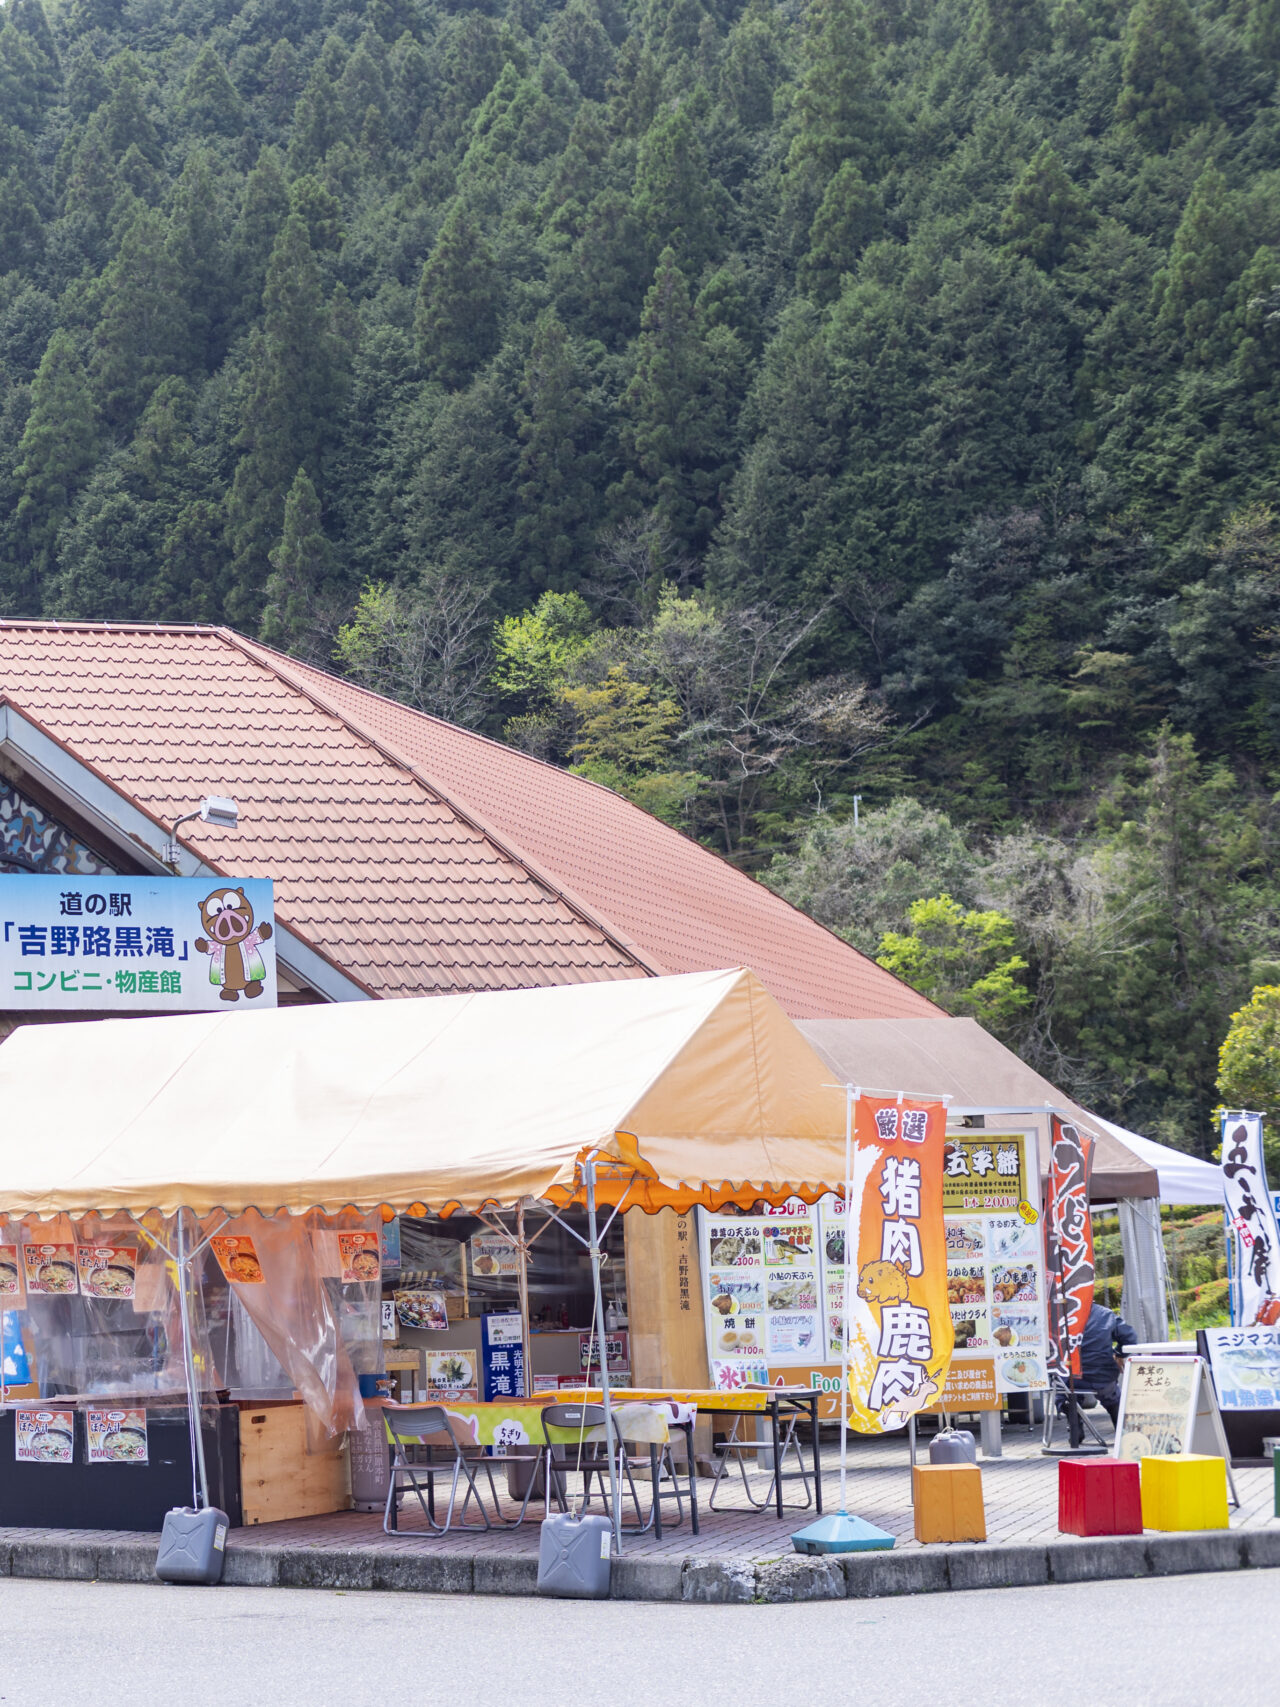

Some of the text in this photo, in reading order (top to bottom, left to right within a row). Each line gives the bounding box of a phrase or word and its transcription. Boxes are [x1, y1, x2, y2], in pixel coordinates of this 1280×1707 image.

[60, 892, 132, 916] 道の駅
[4, 921, 188, 961] 「吉野路黒滝」
[14, 969, 182, 994] コンビニ・物産館
[876, 1110, 928, 1142] 厳選
[946, 1150, 1019, 1176] 五平餅
[881, 1157, 924, 1277] 猪肉
[948, 1239, 982, 1250] コロッケ
[769, 1272, 814, 1280] 小鮎の天ぷら
[743, 1346, 764, 1355] 100円
[1217, 1333, 1280, 1347] ニジマス
[868, 1302, 933, 1410] 鹿肉
[720, 1366, 740, 1389] 氷
[501, 1428, 521, 1439] ちぎり
